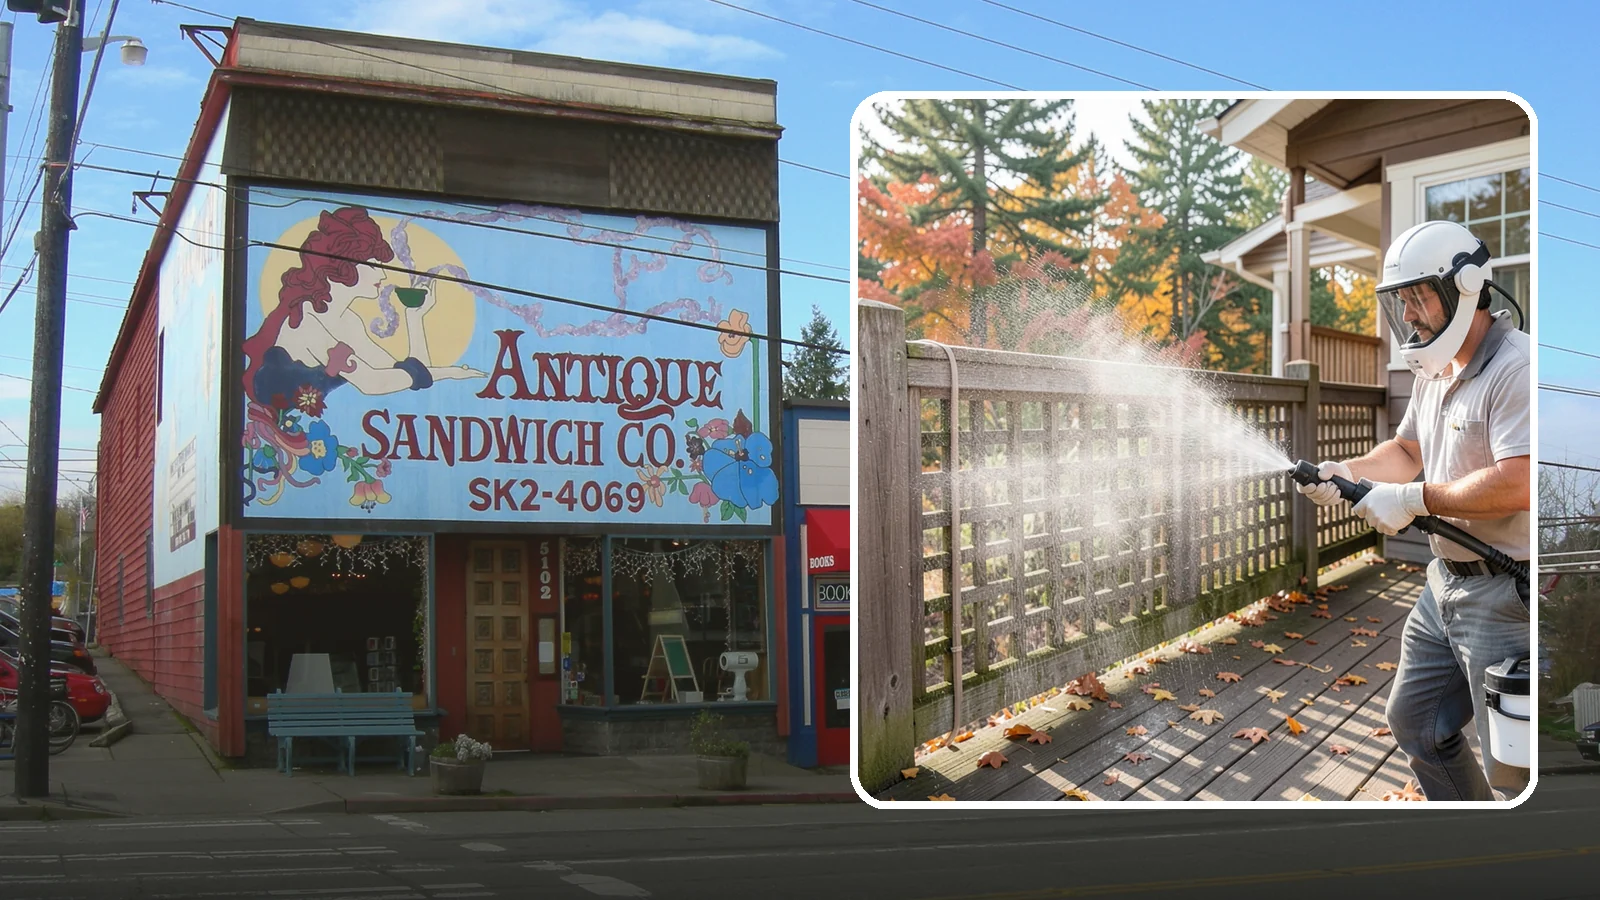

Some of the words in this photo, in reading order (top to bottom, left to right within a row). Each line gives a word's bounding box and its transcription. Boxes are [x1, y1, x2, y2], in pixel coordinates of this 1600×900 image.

[476, 329, 723, 421] ANTIQUE
[362, 408, 604, 467] SANDWICH
[617, 422, 684, 469] CO.
[468, 477, 646, 512] SK2-4069
[540, 541, 551, 599] 5102
[810, 555, 834, 568] BOOKS
